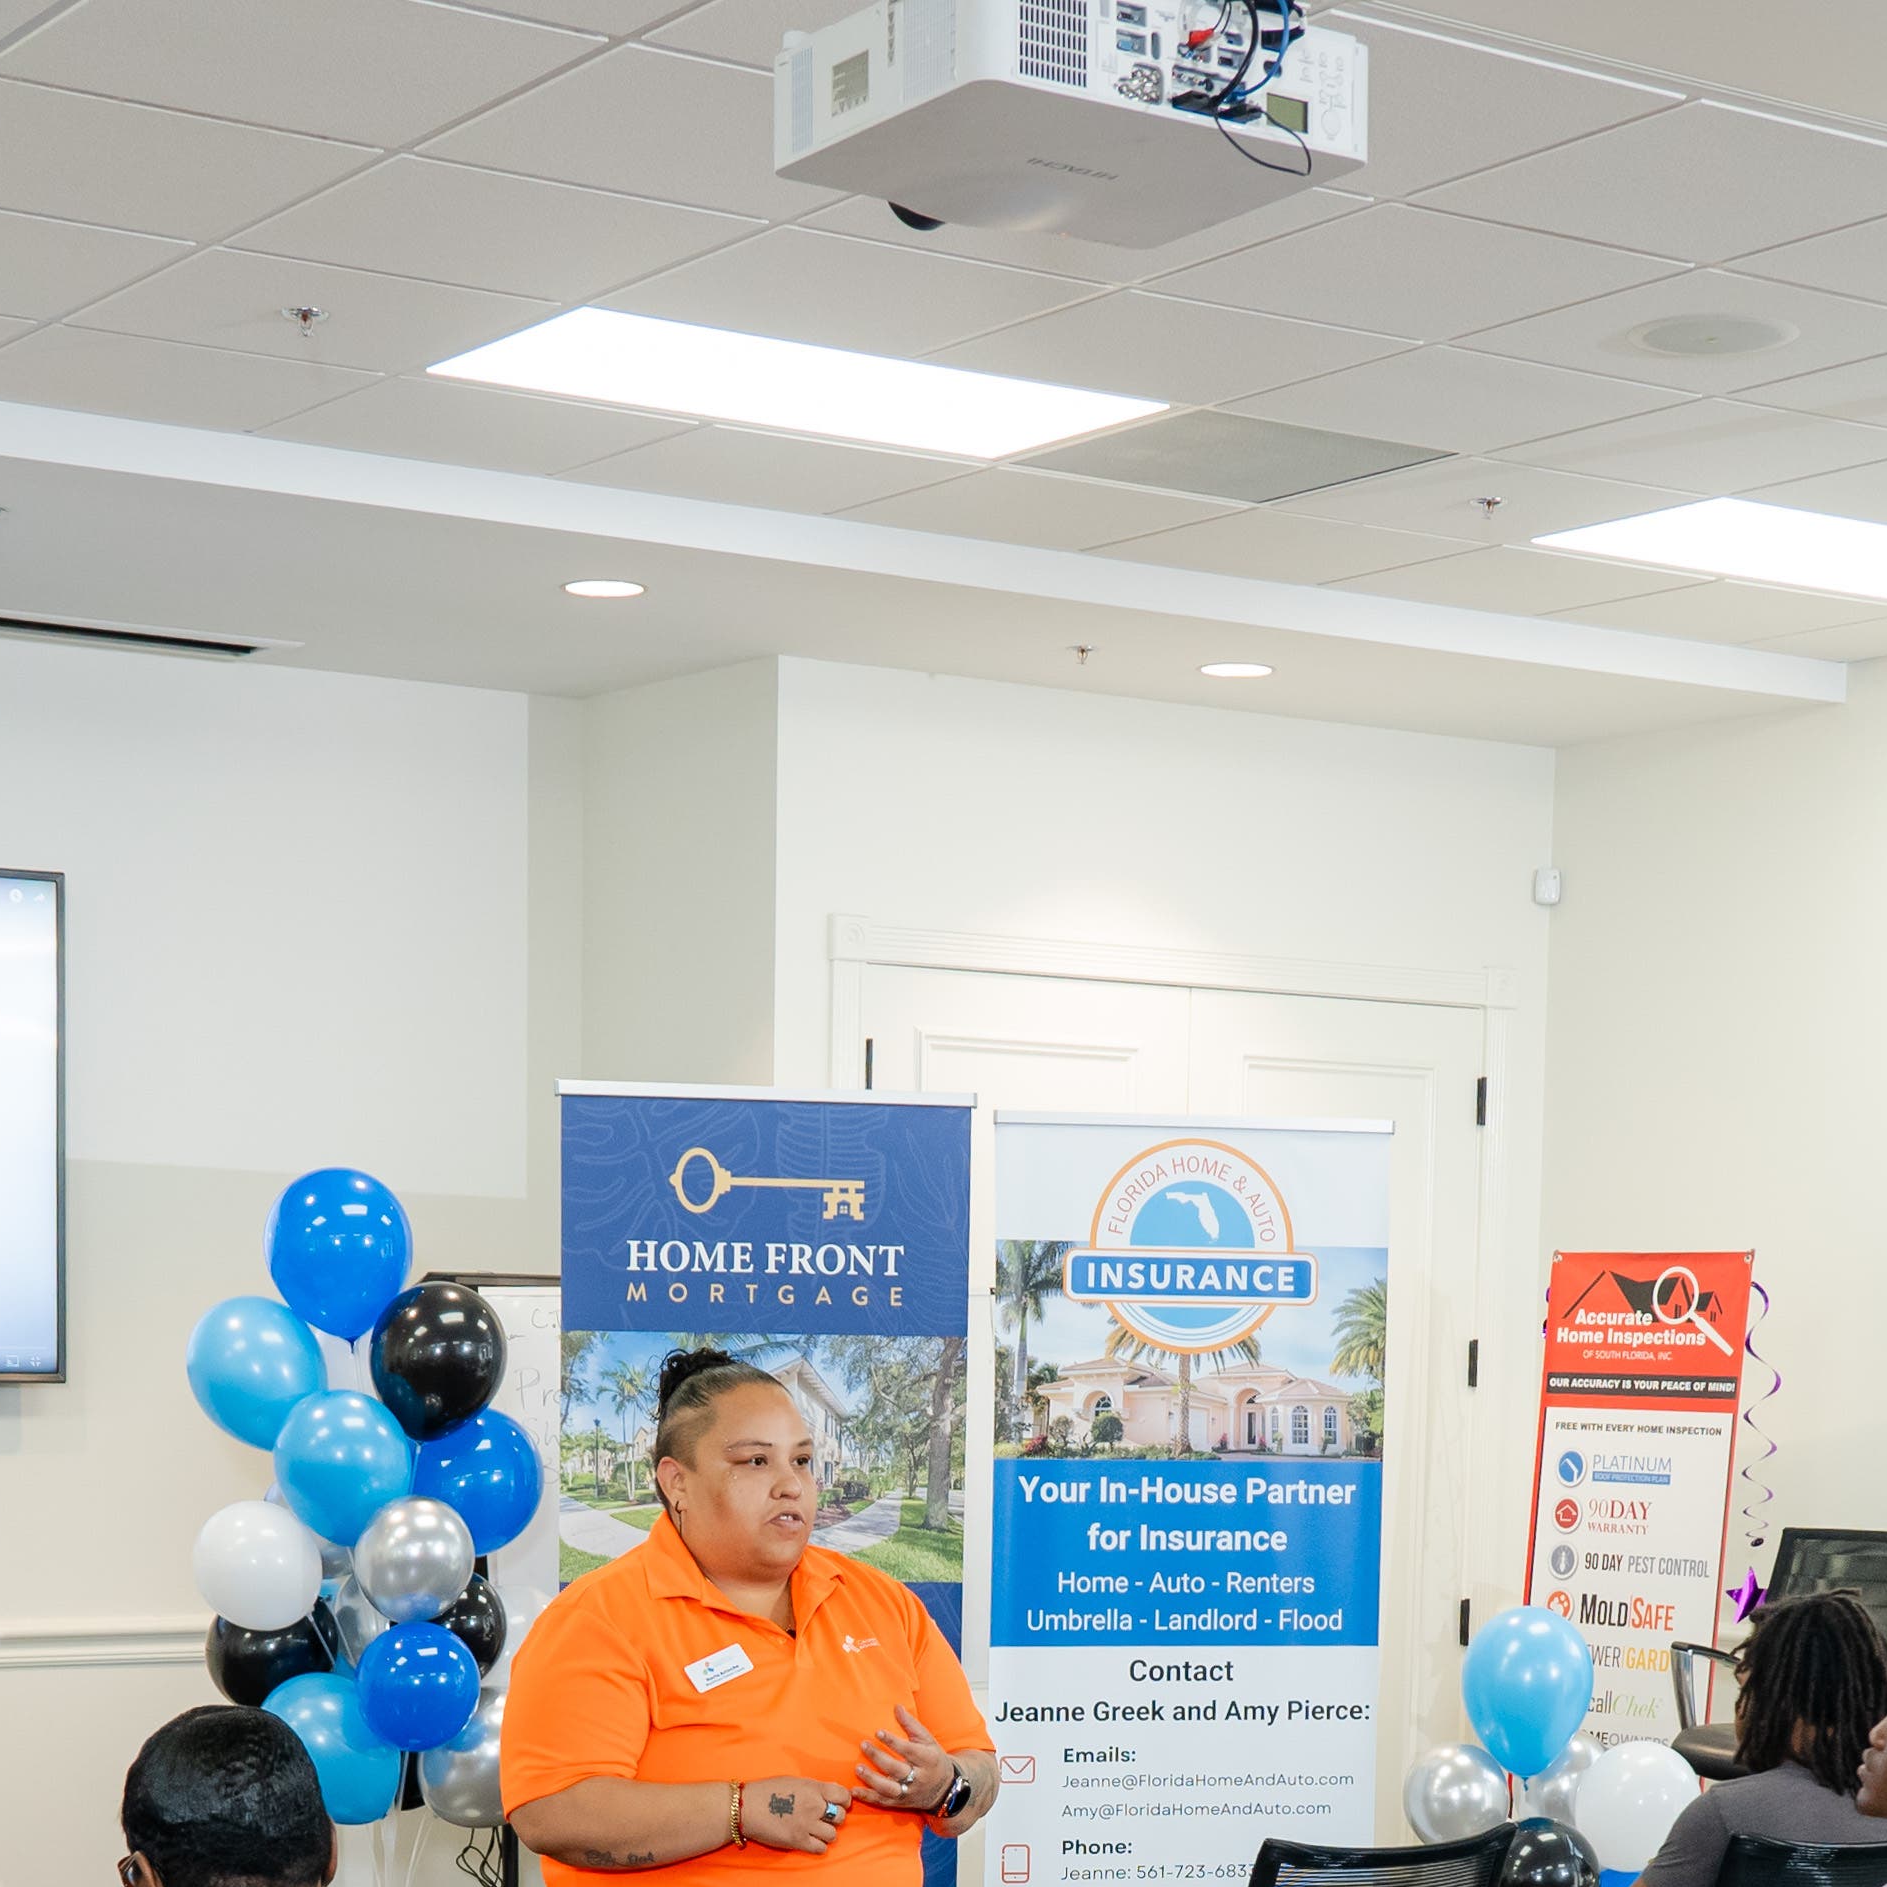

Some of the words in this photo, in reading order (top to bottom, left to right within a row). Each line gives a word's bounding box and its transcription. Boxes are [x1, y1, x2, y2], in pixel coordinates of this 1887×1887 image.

[1108, 1163, 1168, 1235] FLORIDA
[1171, 1156, 1232, 1181] HOME
[1233, 1175, 1247, 1194] &
[1245, 1192, 1276, 1243] AUTO
[626, 1239, 754, 1274] HOME
[765, 1242, 905, 1276] FRONT
[1087, 1262, 1295, 1292] INSURANCE
[626, 1282, 903, 1306] MORTGAGE
[1575, 1308, 1653, 1326] Accurate
[1556, 1327, 1604, 1343] Home
[1607, 1328, 1706, 1347] Inspections
[1583, 1350, 1595, 1359] OF
[1595, 1350, 1621, 1360] SOUTH
[1549, 1377, 1569, 1388] OUR
[1570, 1378, 1620, 1389] ACCURACY
[1622, 1380, 1632, 1390] IS
[1633, 1380, 1659, 1391] YOUR
[1661, 1381, 1691, 1391] PEACE
[1693, 1382, 1706, 1392] OF
[1708, 1382, 1735, 1393] MIND!
[1555, 1422, 1578, 1431] FREE
[1580, 1422, 1603, 1432] WITH
[1605, 1423, 1634, 1433] EVERY
[1637, 1425, 1663, 1434] HOME
[1666, 1425, 1722, 1436] INSPECTION
[1593, 1454, 1672, 1473] PLATINUM
[1019, 1475, 1090, 1503] Your
[1100, 1476, 1237, 1504] In-House
[1246, 1478, 1356, 1504] Partner
[1087, 1523, 1131, 1551] for
[1140, 1524, 1288, 1551] Insurance
[1587, 1522, 1649, 1535] WARRANTY
[1585, 1552, 1599, 1570] 90
[1601, 1554, 1623, 1571] DAY
[1627, 1555, 1656, 1574] PEST
[1658, 1557, 1710, 1578] CONTROL
[1058, 1572, 1128, 1593] Home
[1149, 1572, 1205, 1593] Auto
[1227, 1572, 1315, 1593] Renters
[1027, 1609, 1132, 1631] Umbrella
[1154, 1609, 1257, 1631] Landlord
[1279, 1609, 1343, 1631] Flood
[1129, 1660, 1234, 1682] Contact
[995, 1701, 1085, 1722] Jeanne
[1093, 1701, 1164, 1721] Greek
[1173, 1700, 1216, 1721] and
[1225, 1700, 1279, 1726] Amy
[1287, 1700, 1370, 1721] Pierce:
[1064, 1747, 1137, 1763] Emails:
[1062, 1773, 1354, 1789] Jeanne@FloridaHomeAndAuto.com
[1062, 1802, 1332, 1820] Amy@FloridaHomeAndAuto.com
[1062, 1840, 1133, 1856] Phone:
[1061, 1866, 1131, 1882] Jeanne:
